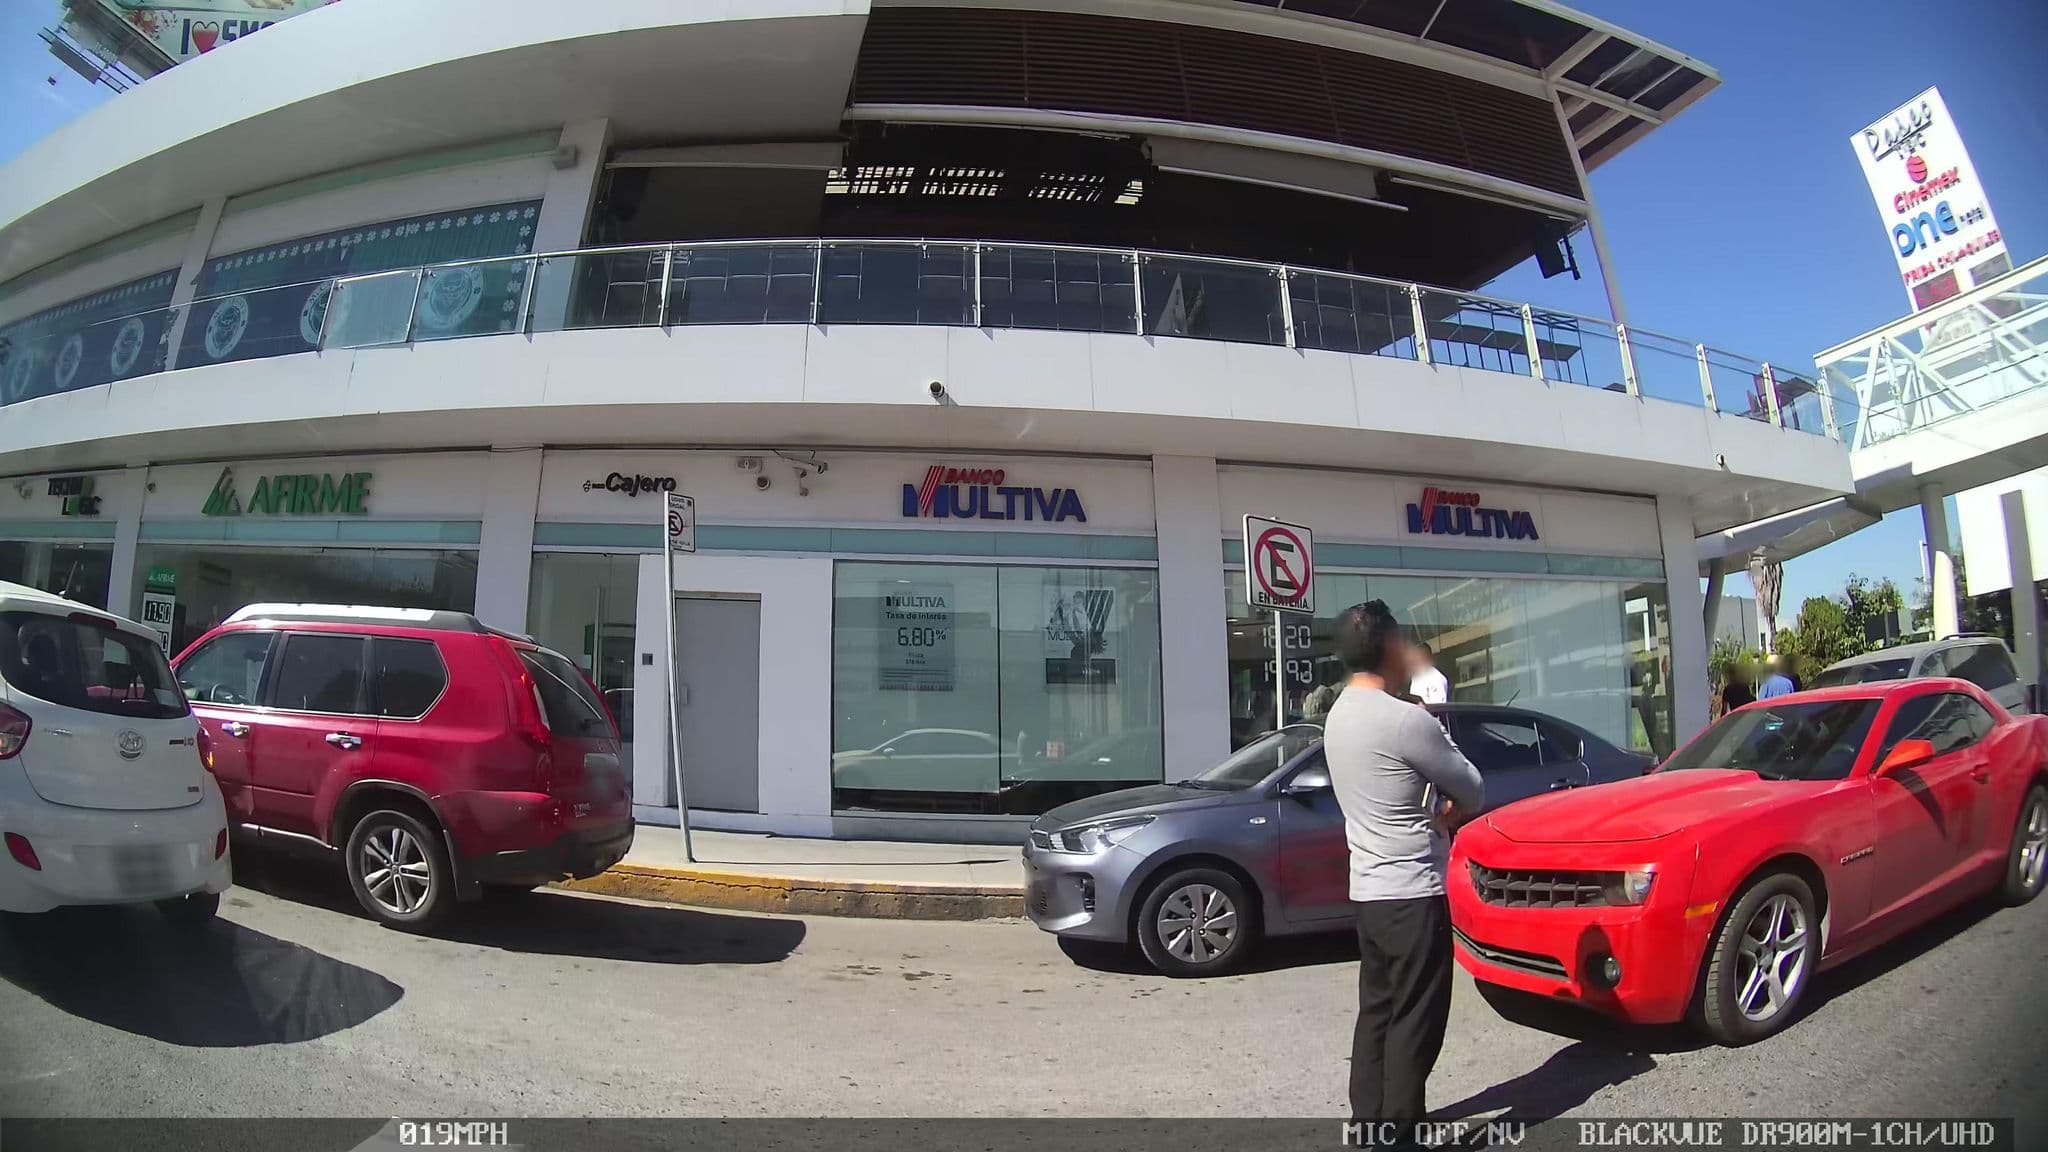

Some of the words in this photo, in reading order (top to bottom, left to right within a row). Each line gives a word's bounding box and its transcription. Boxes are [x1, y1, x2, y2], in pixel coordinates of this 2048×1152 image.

[1893, 166, 1961, 215] Cinemex
[1892, 200, 1959, 258] one
[247, 472, 373, 514] AFIRME
[605, 472, 677, 497] Cajero
[902, 465, 1087, 523] MULTIVA
[944, 468, 1005, 485] BANCO
[1406, 487, 1539, 540] MULTIVA
[886, 595, 945, 608] MULTIVA
[1258, 591, 1271, 605] EN
